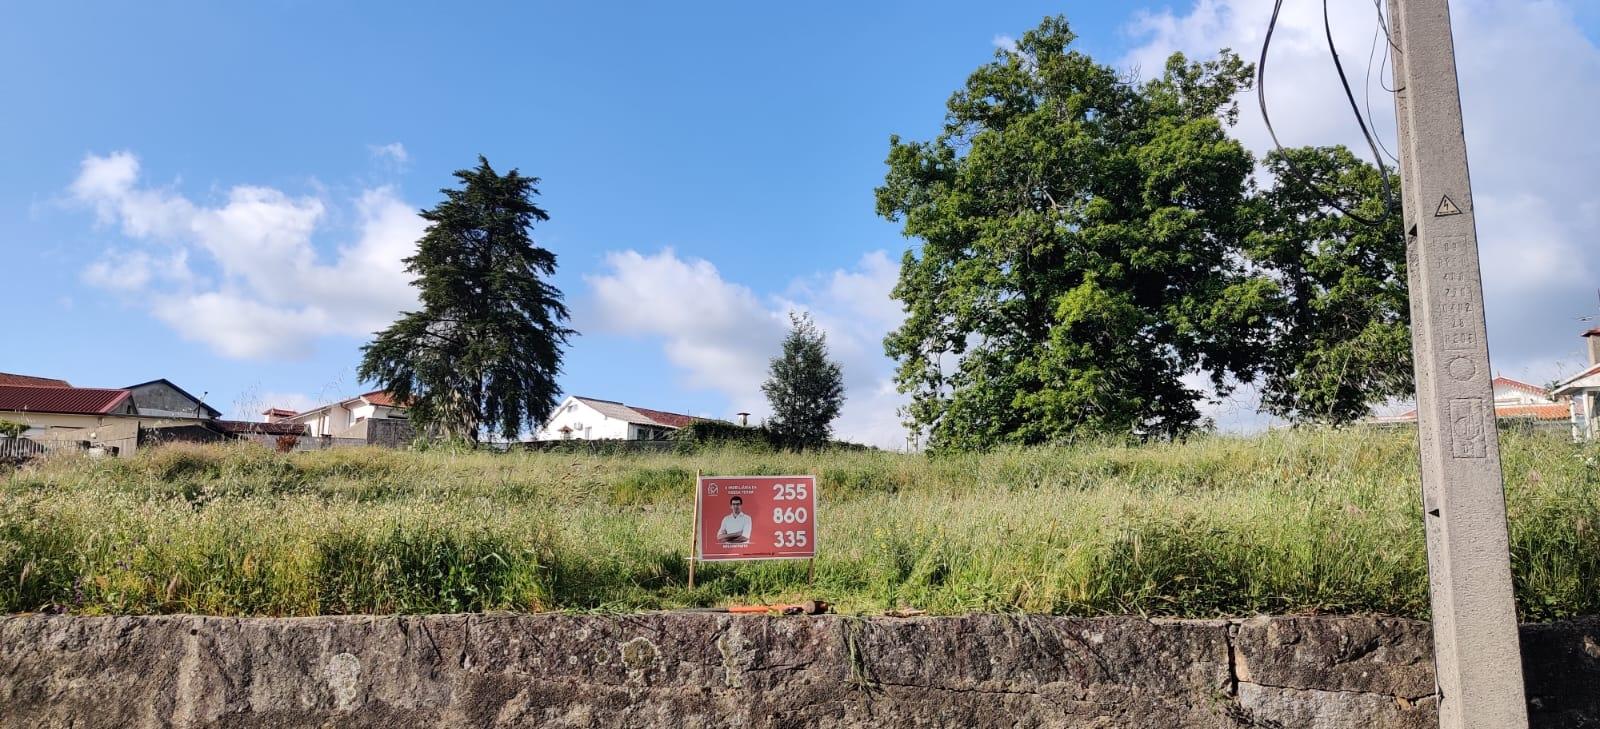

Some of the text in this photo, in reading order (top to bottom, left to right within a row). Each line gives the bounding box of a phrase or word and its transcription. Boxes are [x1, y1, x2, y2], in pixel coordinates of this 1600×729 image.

[773, 483, 808, 501] 255
[773, 506, 808, 524] 860
[773, 530, 808, 548] 335
